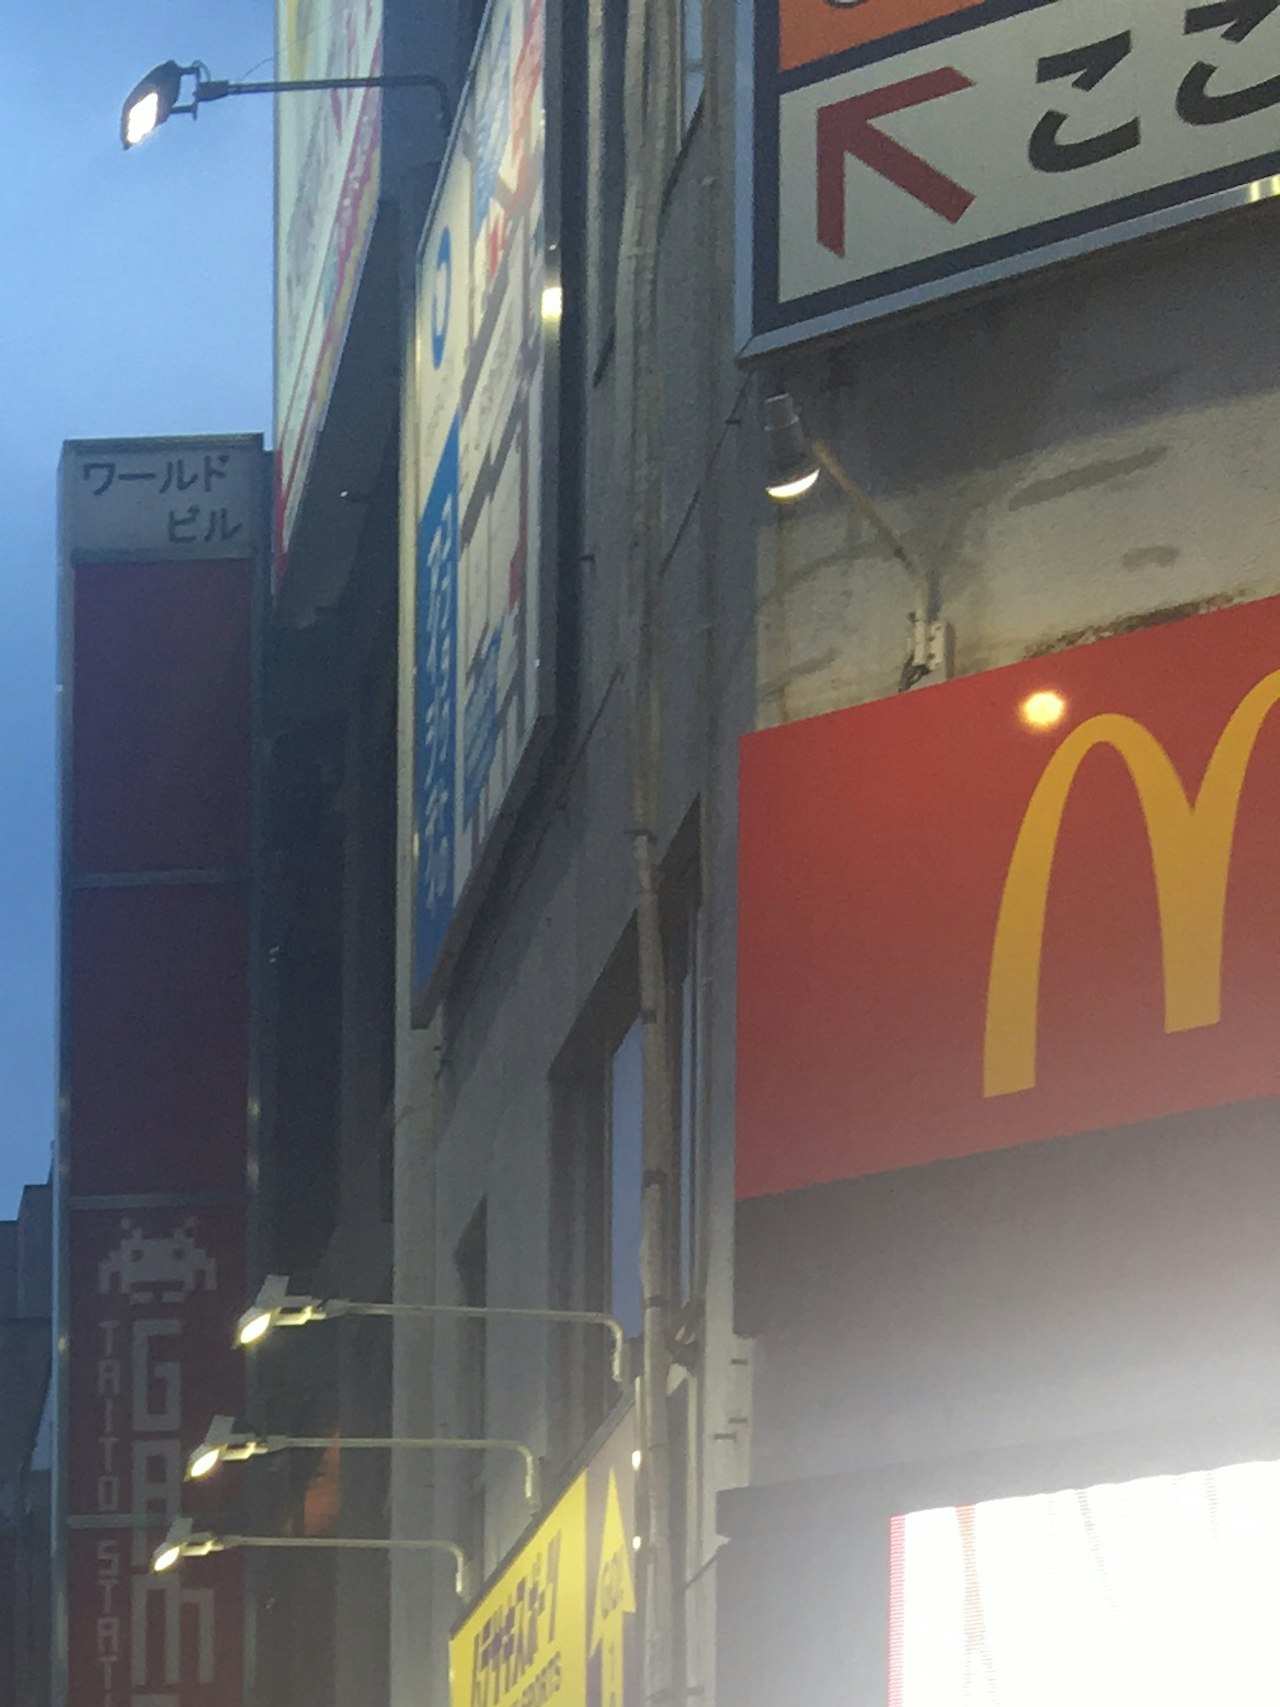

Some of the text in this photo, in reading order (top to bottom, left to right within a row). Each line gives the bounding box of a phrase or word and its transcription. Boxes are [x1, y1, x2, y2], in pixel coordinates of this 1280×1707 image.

[82, 455, 229, 497] ワールド
[167, 507, 242, 544] ビル
